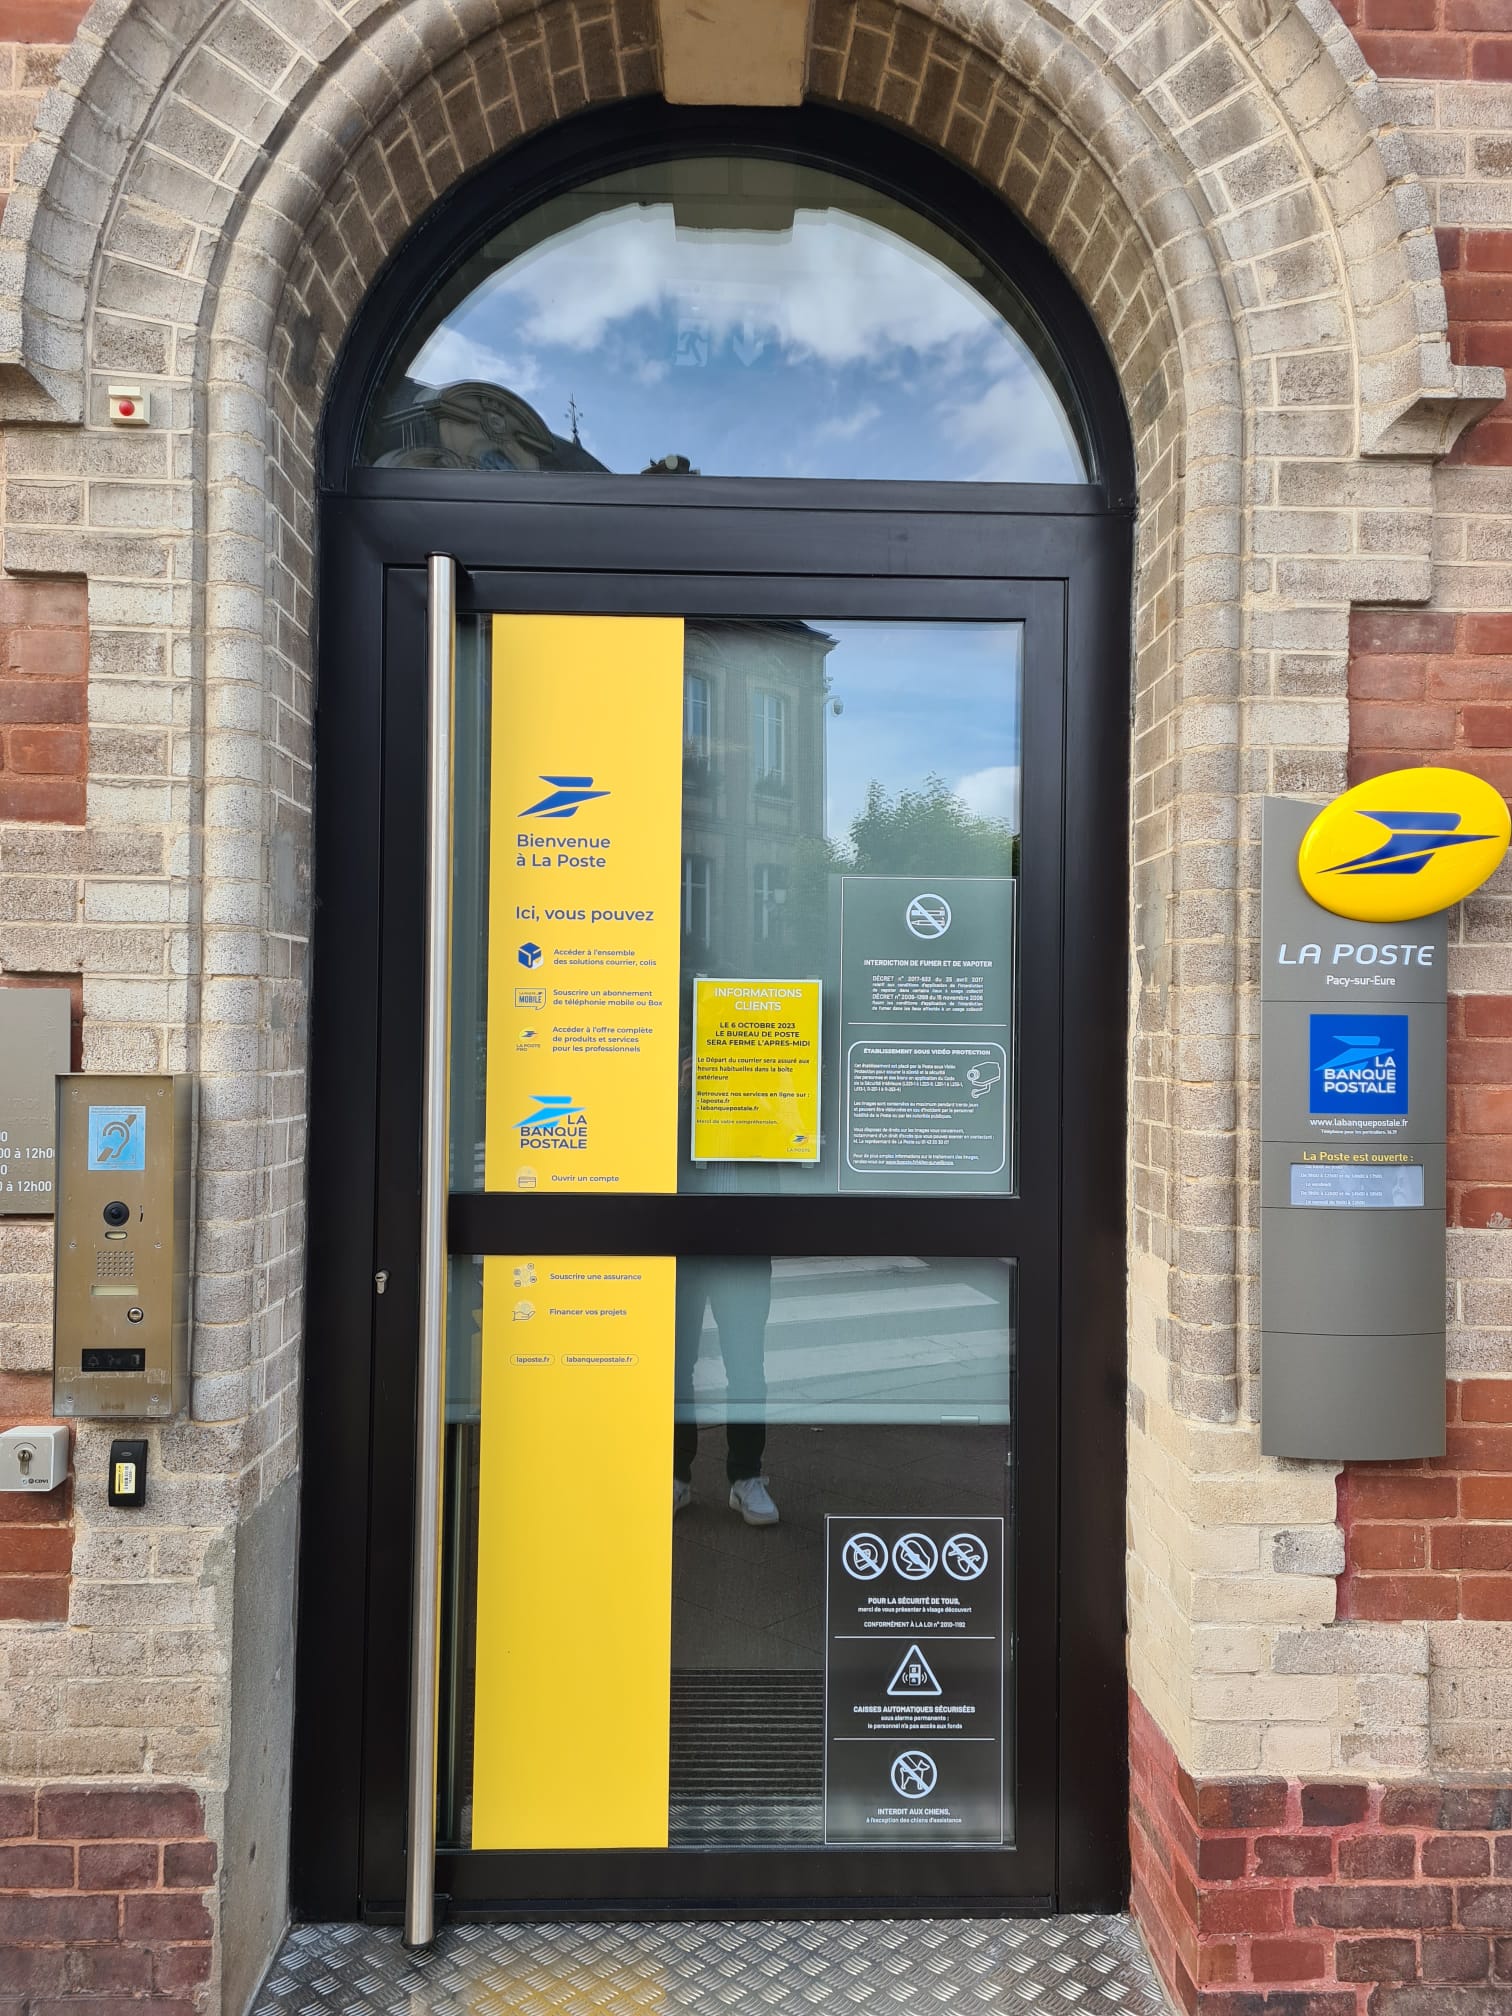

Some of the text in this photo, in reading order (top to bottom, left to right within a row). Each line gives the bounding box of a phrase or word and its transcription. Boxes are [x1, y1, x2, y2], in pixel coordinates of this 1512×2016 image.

[517, 834, 611, 849] Bienvenue
[516, 853, 606, 868] à La Poste
[516, 906, 654, 924] Ici, vous pouvez
[1278, 943, 1435, 966] LA POSTE
[1326, 975, 1396, 987] Pacy-sur-Eure
[714, 988, 802, 998] INFORMATIONS
[735, 1001, 781, 1011] CLIENTS
[1376, 1057, 1396, 1067] LA
[1324, 1069, 1396, 1081] BANQUE
[1324, 1082, 1396, 1093] POSTALE
[568, 1115, 587, 1124] LA
[1310, 1118, 1408, 1128] www.labanquepostale.fr
[521, 1127, 587, 1137] BANQUE
[521, 1139, 587, 1148] POSTALE
[15, 1148, 20, 1158] à
[26, 1148, 55, 1158] 12h0
[1304, 1152, 1316, 1160] La
[1320, 1152, 1350, 1161] Poste
[1353, 1153, 1368, 1161] est
[1372, 1153, 1408, 1162] ouverte
[6, 1181, 13, 1191] à
[18, 1181, 51, 1192] 12h00
